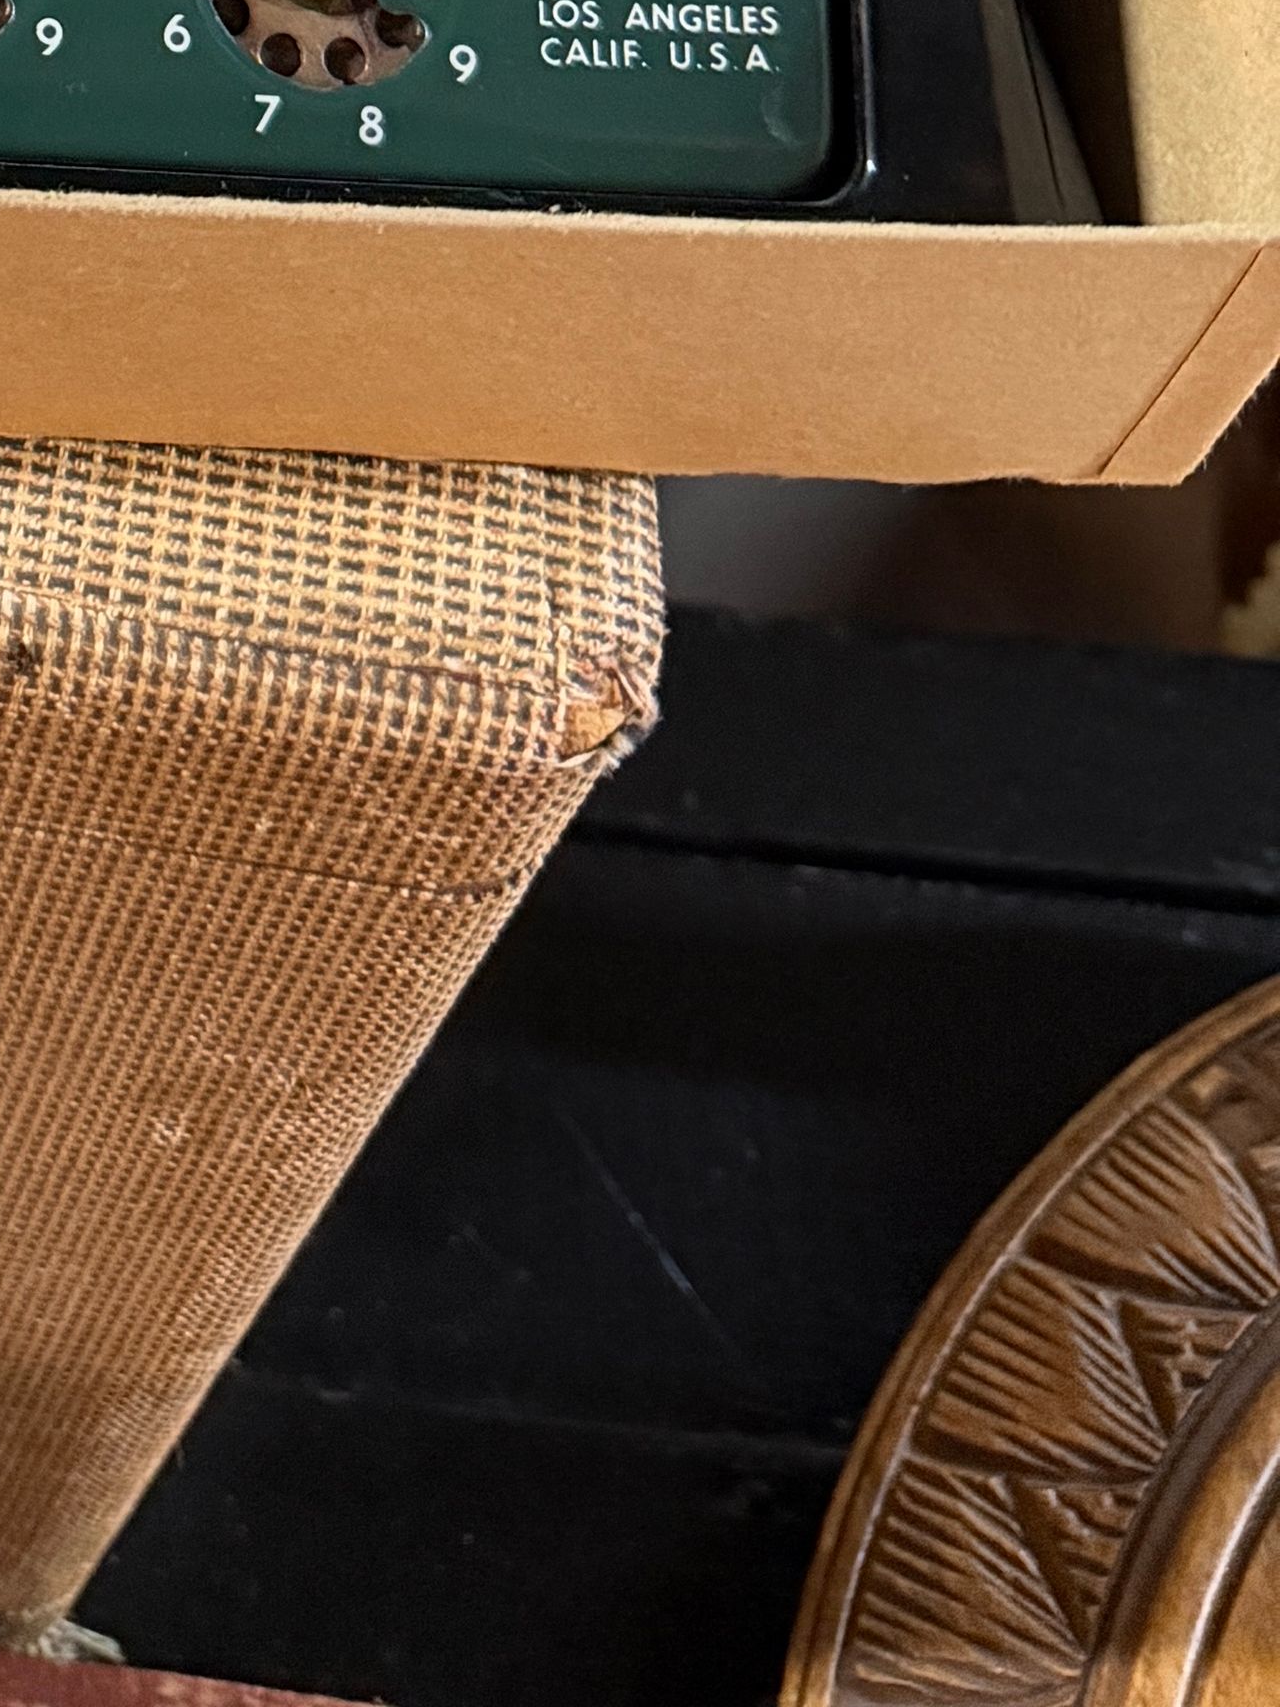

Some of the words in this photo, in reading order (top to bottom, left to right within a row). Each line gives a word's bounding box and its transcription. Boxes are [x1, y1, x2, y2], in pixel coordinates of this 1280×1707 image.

[539, 0, 599, 28] LOS
[625, 3, 778, 34] ANGELES
[35, 17, 63, 56] 9
[541, 38, 646, 67] CALIF.
[670, 41, 780, 72] U.S.A.
[163, 14, 191, 53] 6
[254, 94, 281, 133] 7
[359, 105, 384, 146] 8
[449, 44, 477, 83] 9
